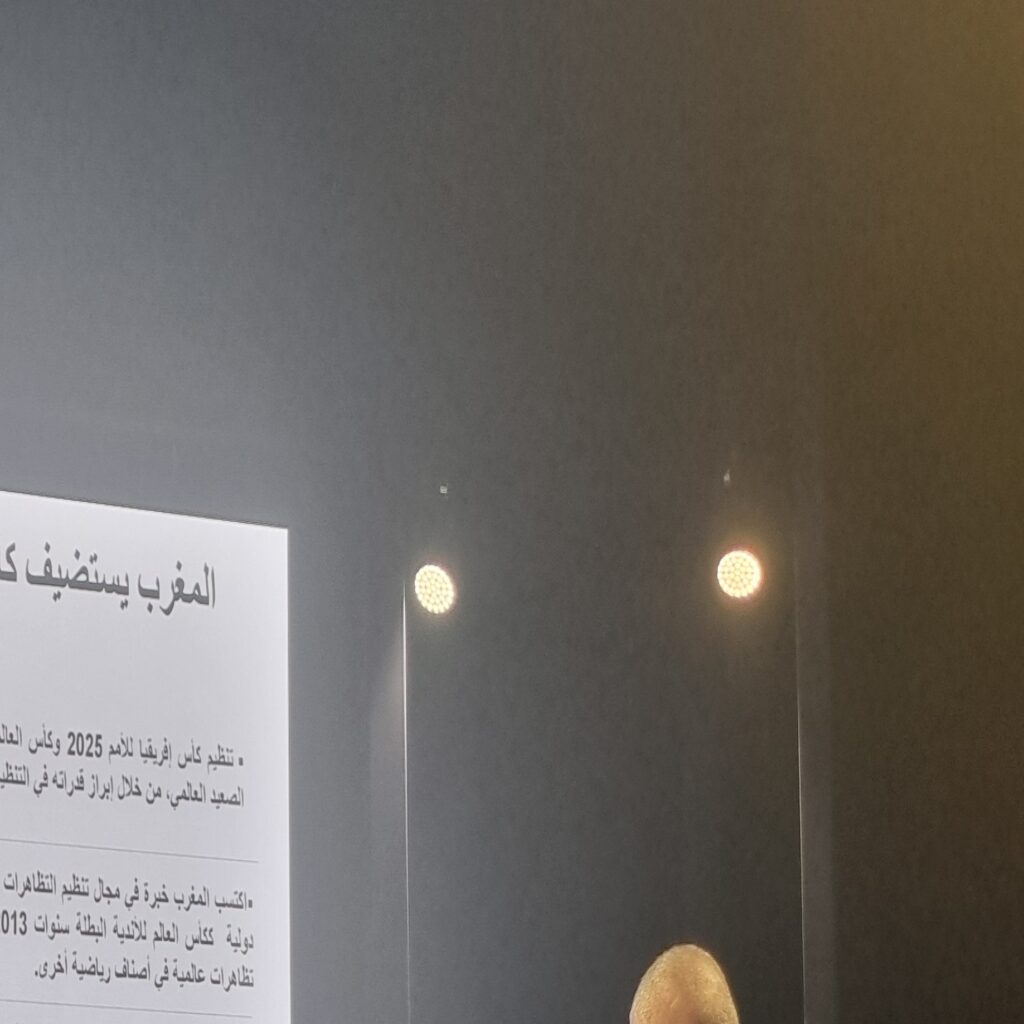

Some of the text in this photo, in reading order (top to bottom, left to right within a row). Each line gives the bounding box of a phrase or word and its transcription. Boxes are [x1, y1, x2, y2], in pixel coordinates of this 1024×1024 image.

[24, 541, 130, 611] يستضيف
[138, 560, 216, 616] المغرب
[28, 724, 61, 756] وكأس
[67, 731, 103, 758] 2025
[108, 733, 133, 762] للأمم
[139, 737, 172, 768] إفريقيا
[178, 740, 202, 769] كأس
[207, 744, 234, 772] تنظيم
[33, 765, 48, 798] في
[52, 768, 84, 797] قدراته
[88, 774, 113, 801] إبراز
[117, 774, 142, 800] خلال
[146, 782, 162, 804] من
[166, 782, 206, 810] العالمي،
[210, 786, 244, 809] الصعيد
[3, 870, 56, 898] التظاهرات
[61, 873, 89, 903] تنظيم
[94, 877, 120, 905] مجال
[124, 877, 139, 911] في
[144, 882, 169, 908] خبرة
[173, 885, 209, 912] المغرب
[214, 891, 247, 913] اكتسب
[34, 914, 70, 938] سنوات
[76, 912, 106, 941] البطلة
[112, 915, 147, 944] للأندية
[153, 921, 179, 949] العالم
[185, 921, 214, 951] ككأس
[226, 924, 254, 955] دولية
[35, 948, 254, 992] تظاهرات عالمية في أصناف رياضية أخرى.
